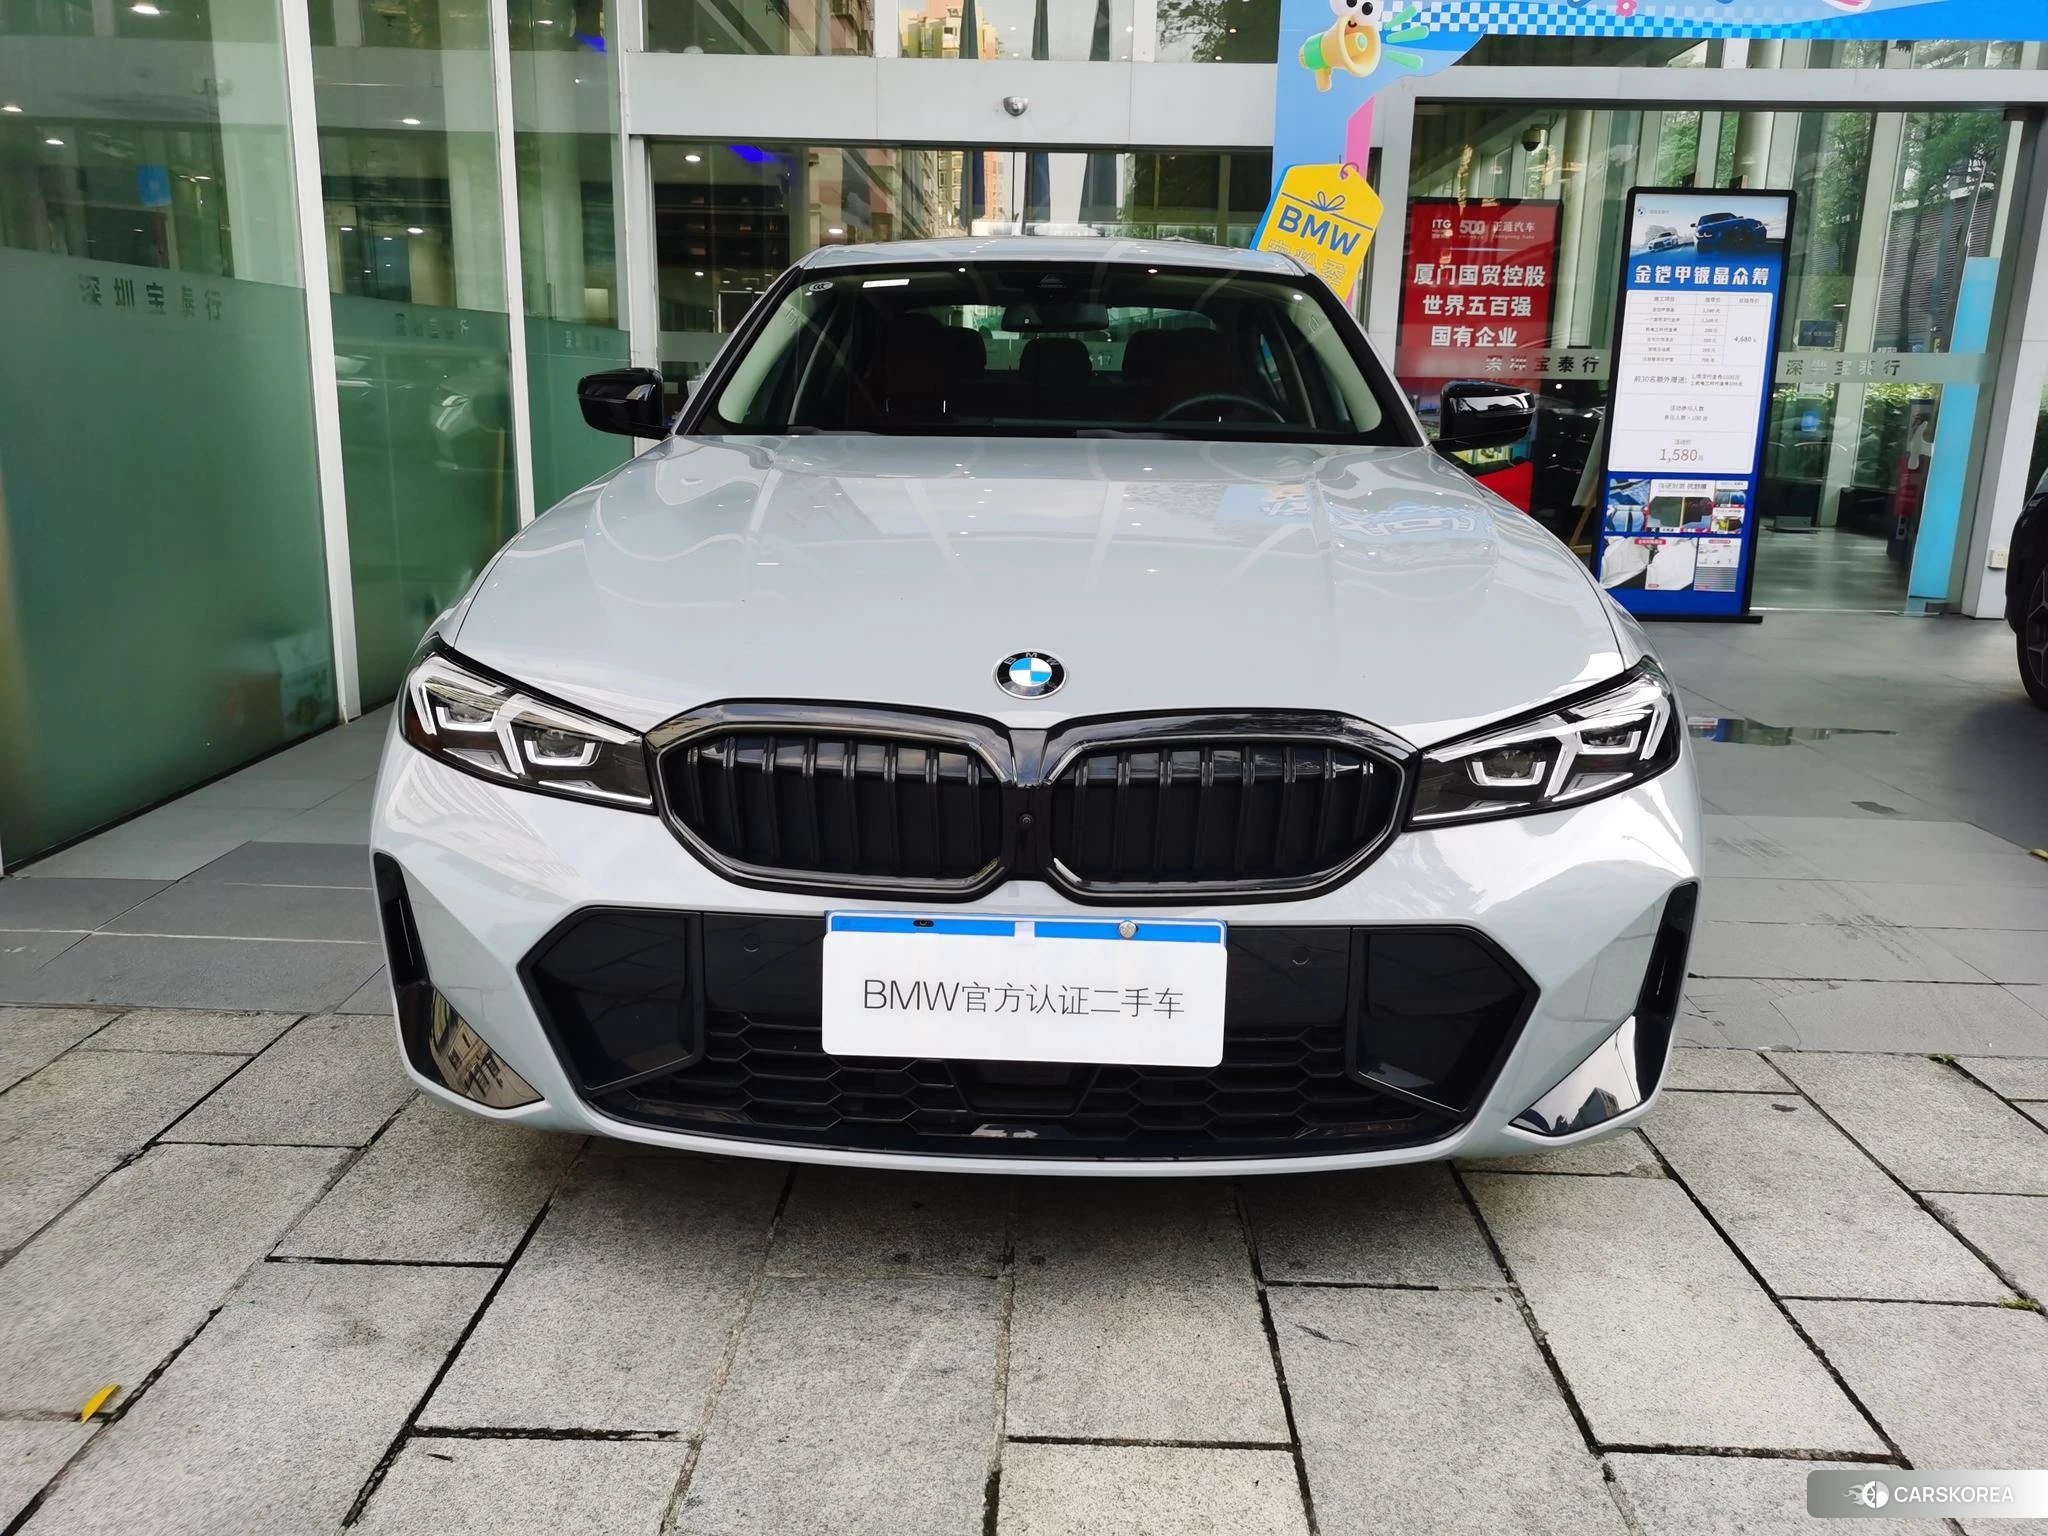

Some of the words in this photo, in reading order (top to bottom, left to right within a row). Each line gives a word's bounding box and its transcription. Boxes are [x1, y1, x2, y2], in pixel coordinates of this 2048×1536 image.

[1278, 204, 1361, 256] BMW
[1413, 263, 1545, 287] 厦门国贸控股
[1634, 265, 1769, 286] 金铠甲镀晶众筹
[1423, 294, 1531, 317] 世界五百强
[1431, 326, 1517, 347] 国有企业
[1659, 449, 1698, 463] 1,580
[863, 979, 1185, 1019] BMW官方认证二手车
